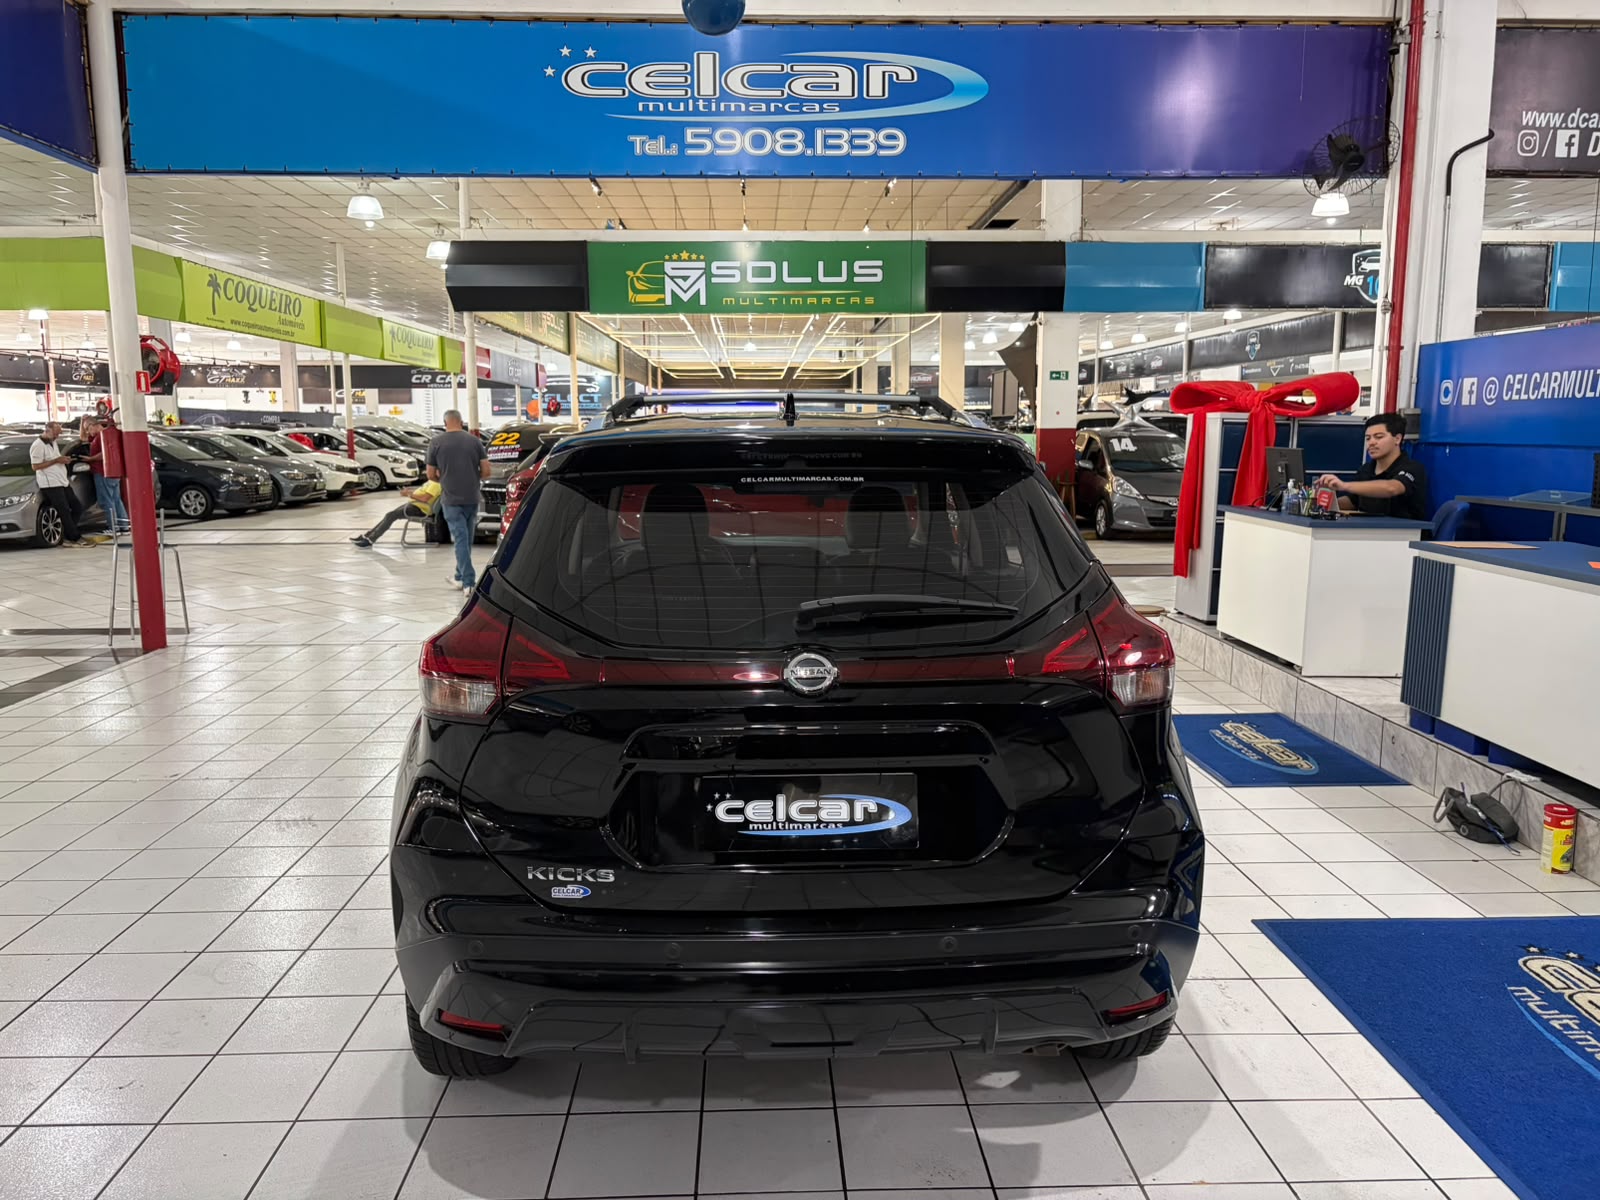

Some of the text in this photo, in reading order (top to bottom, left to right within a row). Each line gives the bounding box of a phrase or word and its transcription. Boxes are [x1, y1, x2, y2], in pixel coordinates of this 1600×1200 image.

[561, 51, 918, 99] celcar
[637, 98, 840, 113] multimarcas
[1522, 107, 1600, 129] www.dca
[627, 127, 907, 157] Tel.: 5908.1339
[710, 260, 884, 283] SOLUS
[1343, 275, 1364, 286] MG
[223, 278, 302, 318] COQUEIRO
[722, 297, 875, 305] MULTIMARCAS
[396, 326, 434, 351] COQUEIRO
[411, 374, 432, 383] CR
[491, 432, 520, 445] 22
[1110, 437, 1138, 452] 14
[714, 793, 878, 823] celcar
[749, 821, 844, 830] multimarcas
[526, 866, 616, 883] KICKS
